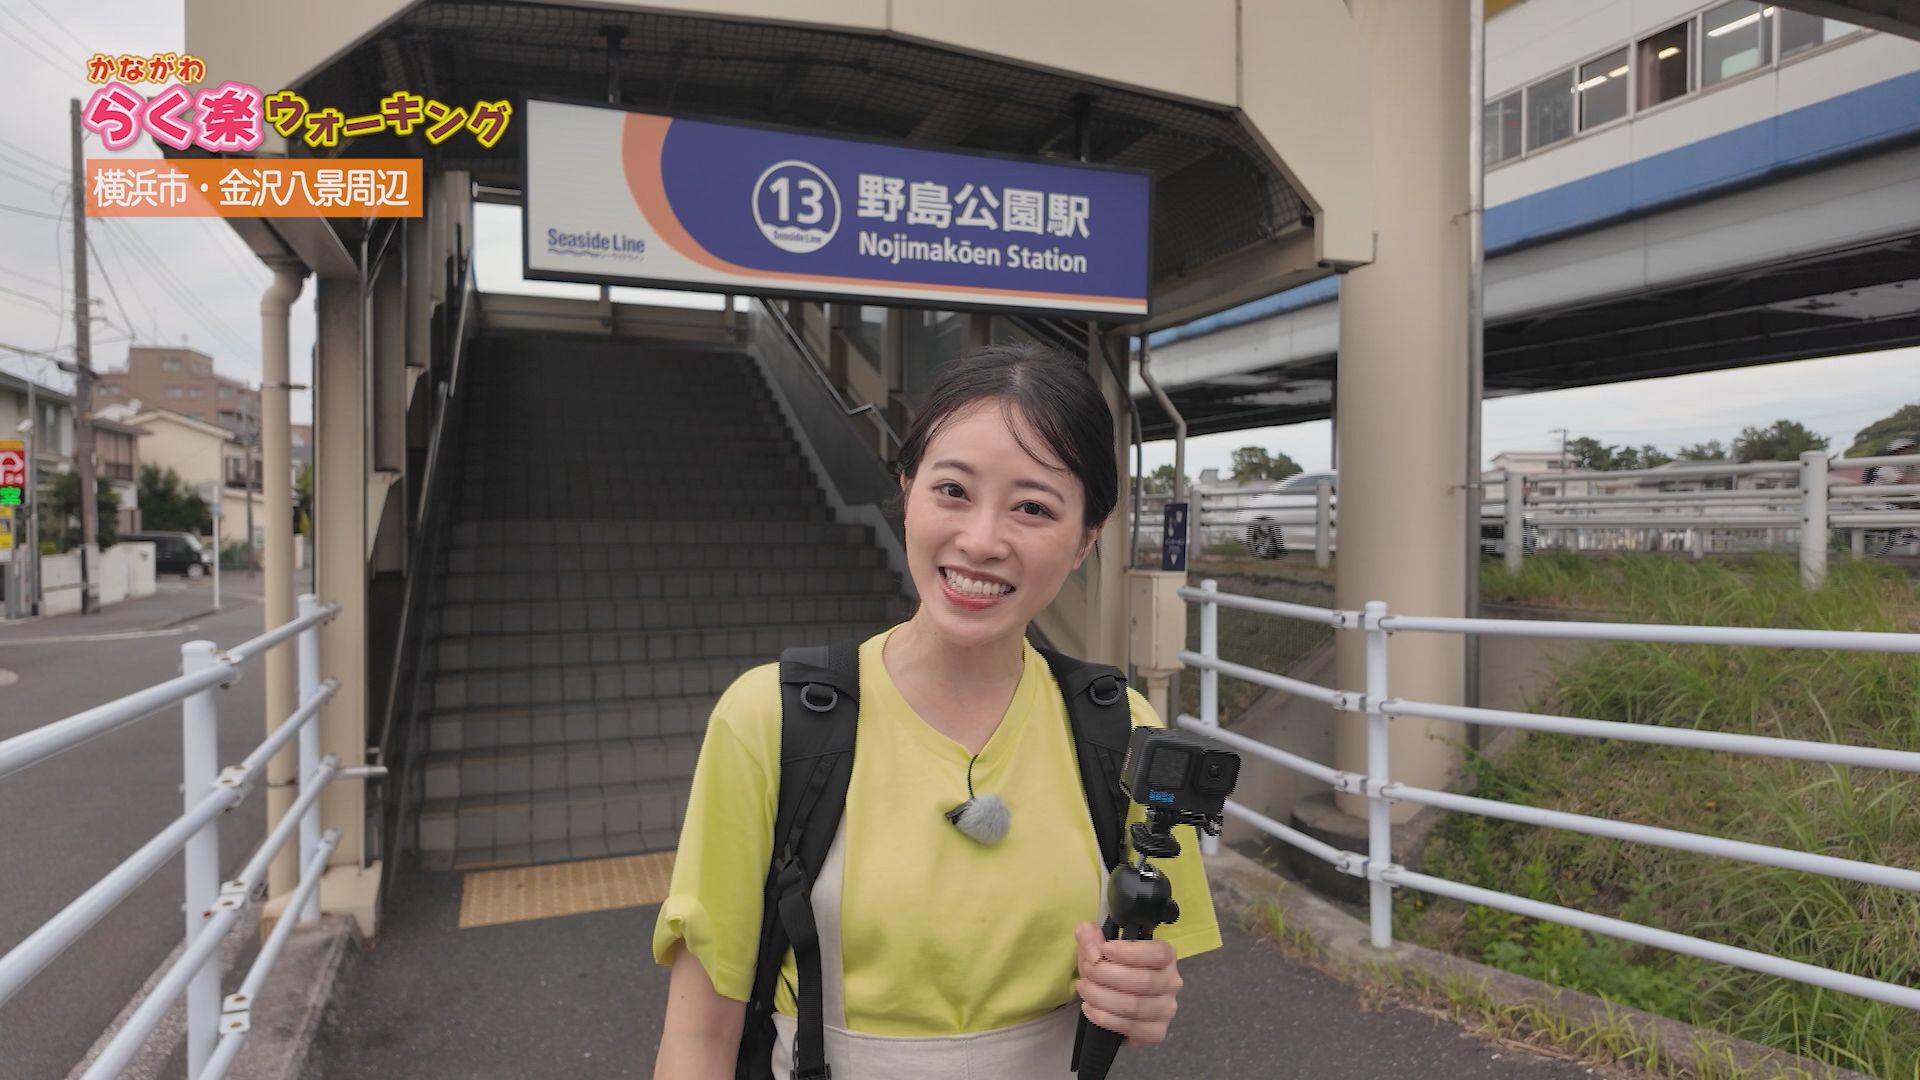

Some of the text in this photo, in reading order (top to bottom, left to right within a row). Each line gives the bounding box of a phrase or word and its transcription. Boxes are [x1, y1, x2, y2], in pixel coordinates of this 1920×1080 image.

[768, 176, 824, 225] 13
[856, 172, 1091, 239] 野島公園駅
[547, 227, 646, 254] Seaside Line
[858, 230, 1089, 274] Nojimakōen Station
